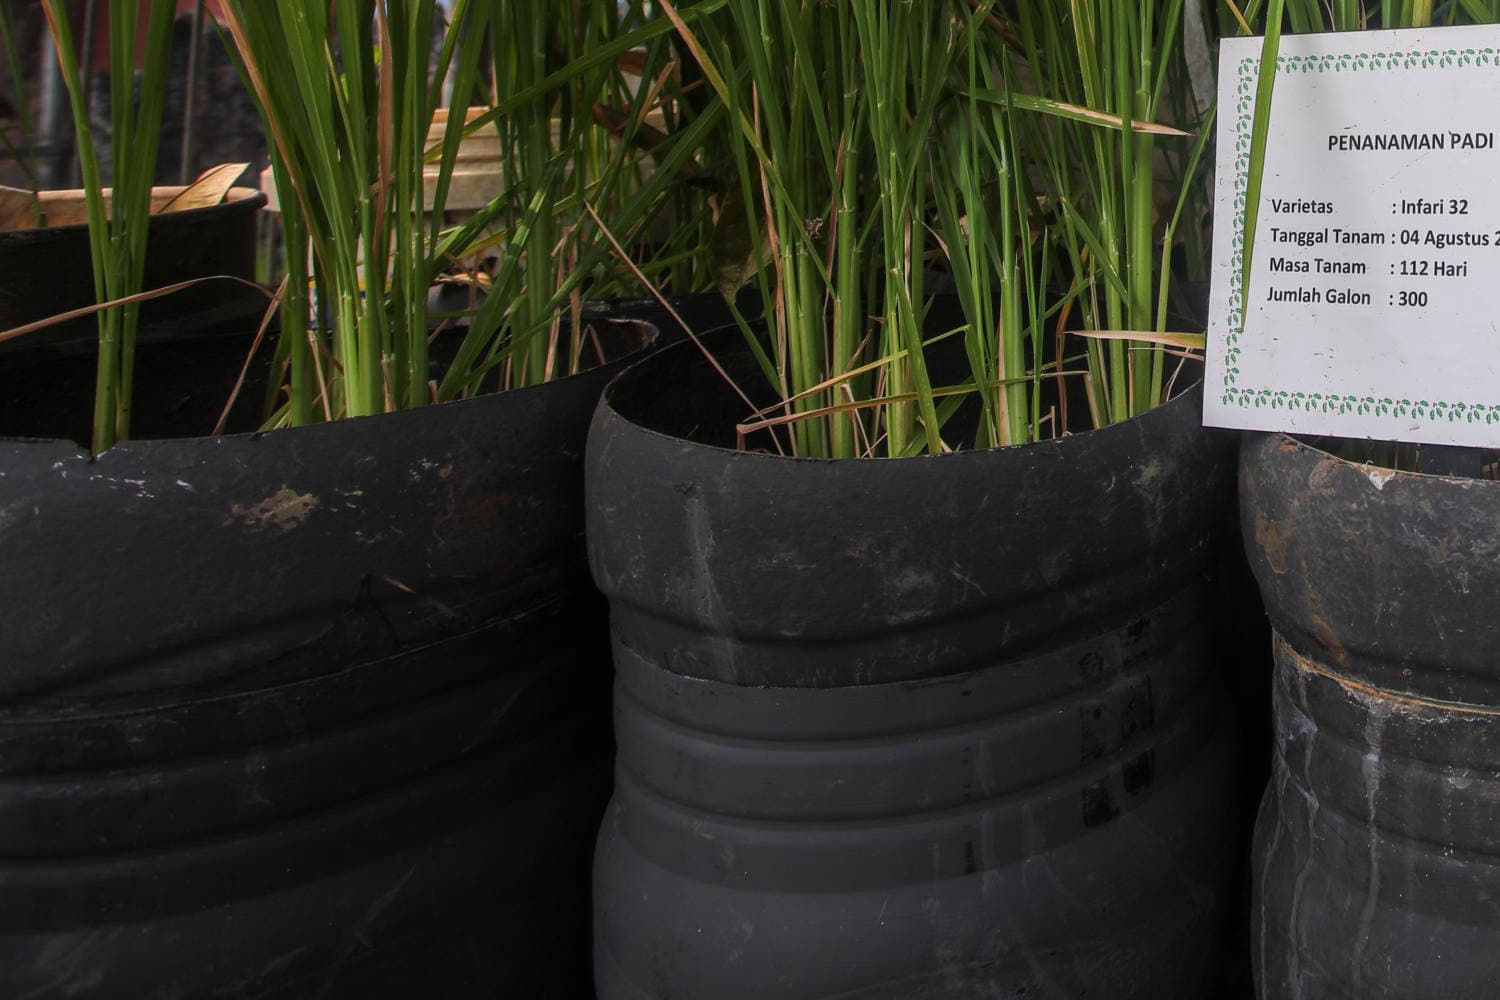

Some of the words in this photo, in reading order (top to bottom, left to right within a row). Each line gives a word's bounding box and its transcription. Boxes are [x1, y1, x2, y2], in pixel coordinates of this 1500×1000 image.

[1328, 130, 1445, 151] PENANAMAN
[1450, 130, 1494, 150] PADI
[1271, 198, 1334, 214] Varietas
[1401, 199, 1444, 215] Infari
[1448, 199, 1469, 215] 32
[1270, 227, 1329, 247] Tanggal
[1333, 228, 1385, 245] Tanam
[1400, 229, 1420, 245] 04
[1424, 230, 1490, 250] Agustus
[1269, 257, 1310, 273] Masa
[1314, 258, 1366, 275] Tanam
[1400, 260, 1429, 276] 112
[1433, 260, 1468, 277] Hari
[1267, 287, 1321, 303] Jumlah
[1325, 288, 1371, 305] Galon
[1398, 290, 1428, 307] 300
